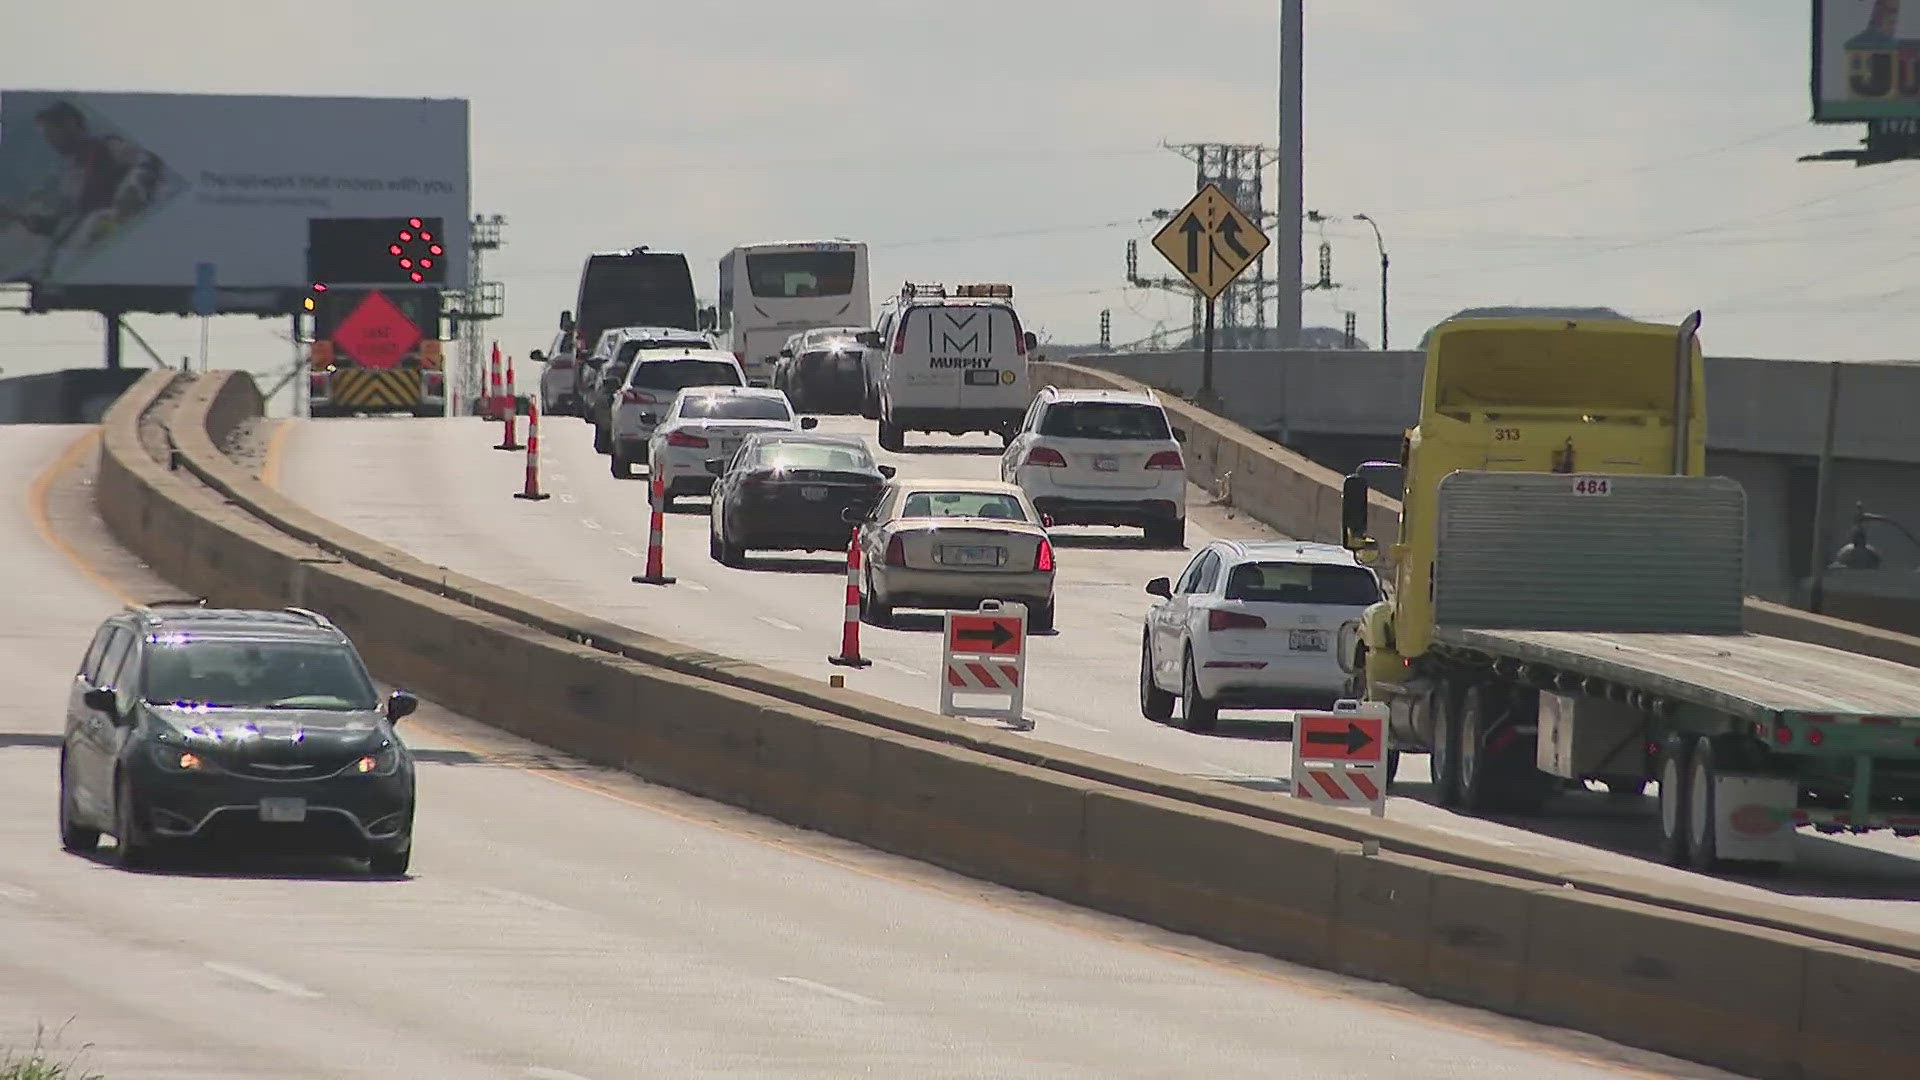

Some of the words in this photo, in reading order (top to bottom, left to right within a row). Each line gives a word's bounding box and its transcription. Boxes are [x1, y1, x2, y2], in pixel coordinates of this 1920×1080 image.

[200, 170, 226, 188] The
[229, 173, 297, 190] network
[299, 175, 331, 190] that
[336, 178, 384, 192] moves
[386, 176, 420, 192] with
[929, 356, 994, 369] MURPHY
[1494, 428, 1521, 441] 313
[1575, 480, 1608, 494] 484
